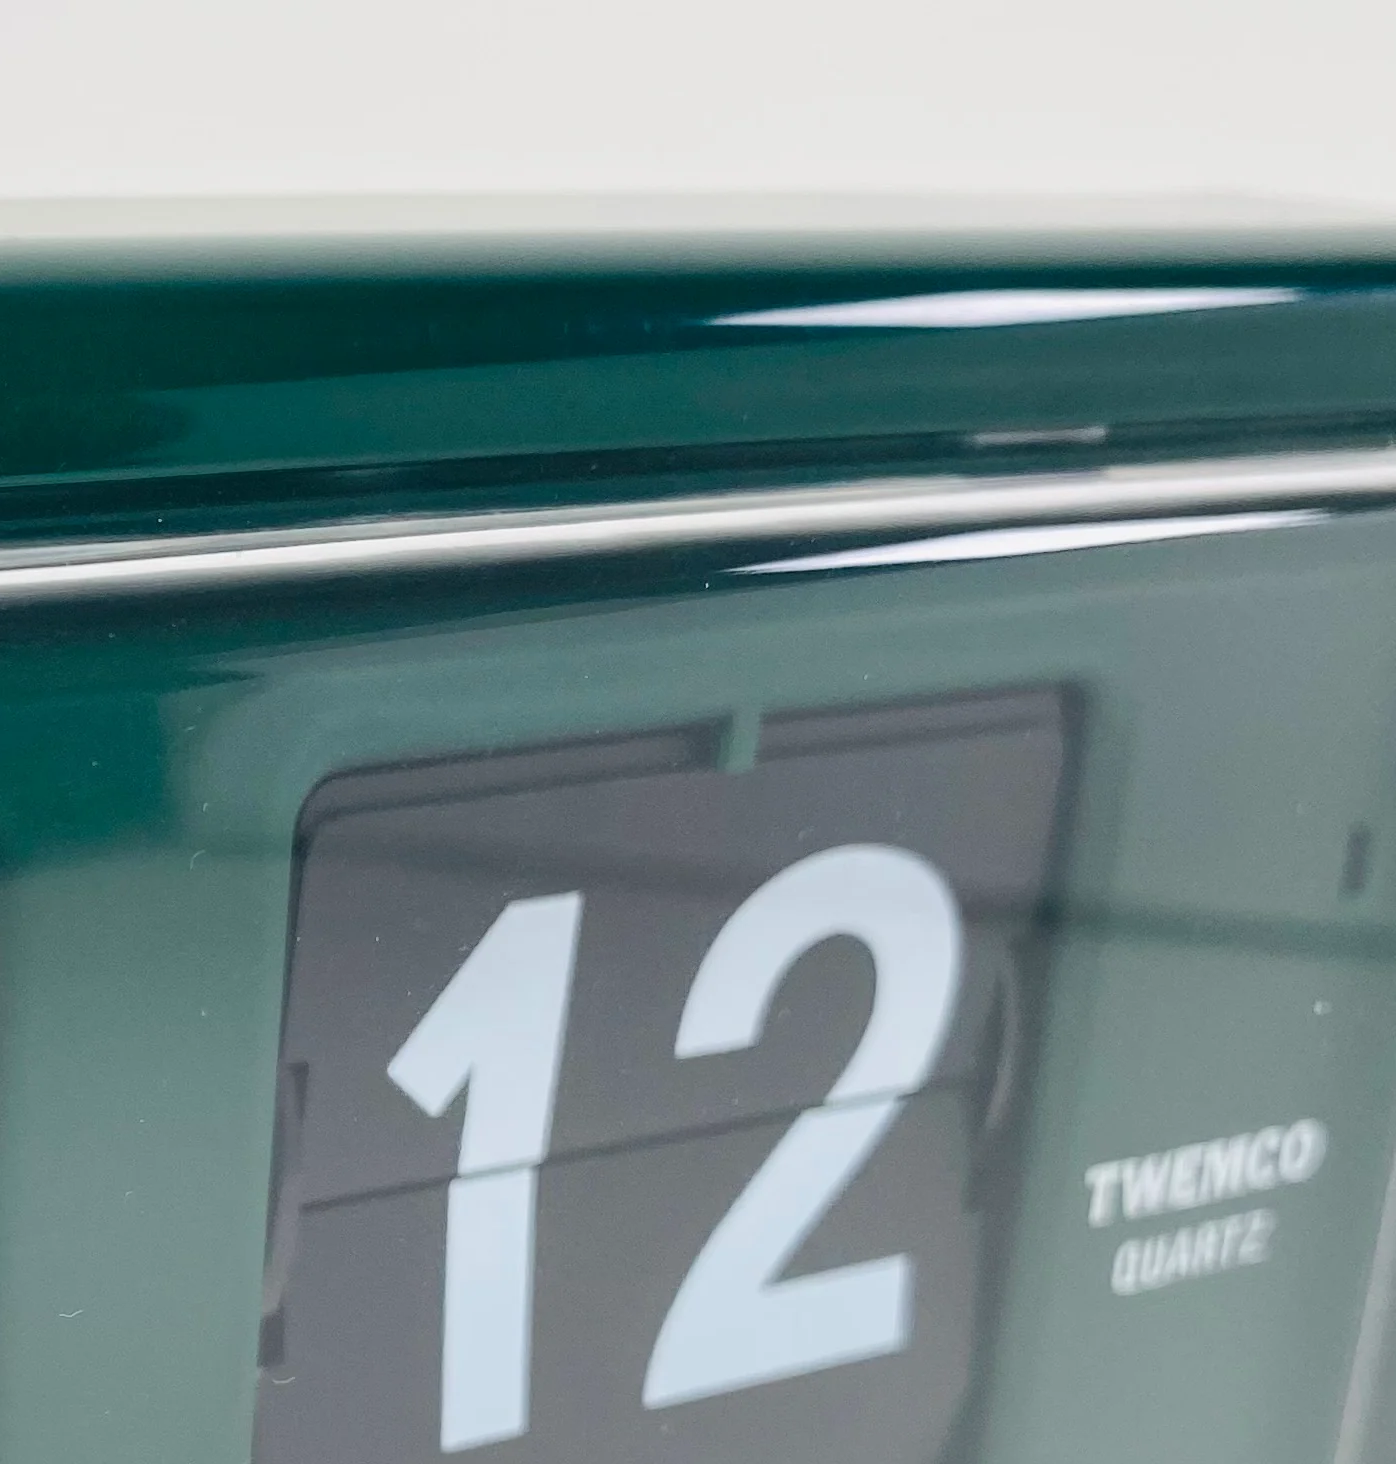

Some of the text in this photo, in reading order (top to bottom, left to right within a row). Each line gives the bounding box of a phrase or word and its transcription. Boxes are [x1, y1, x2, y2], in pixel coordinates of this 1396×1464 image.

[387, 844, 961, 1452] 12
[1084, 1118, 1328, 1228] TWEMCO
[1111, 1209, 1276, 1296] QUARTZ
